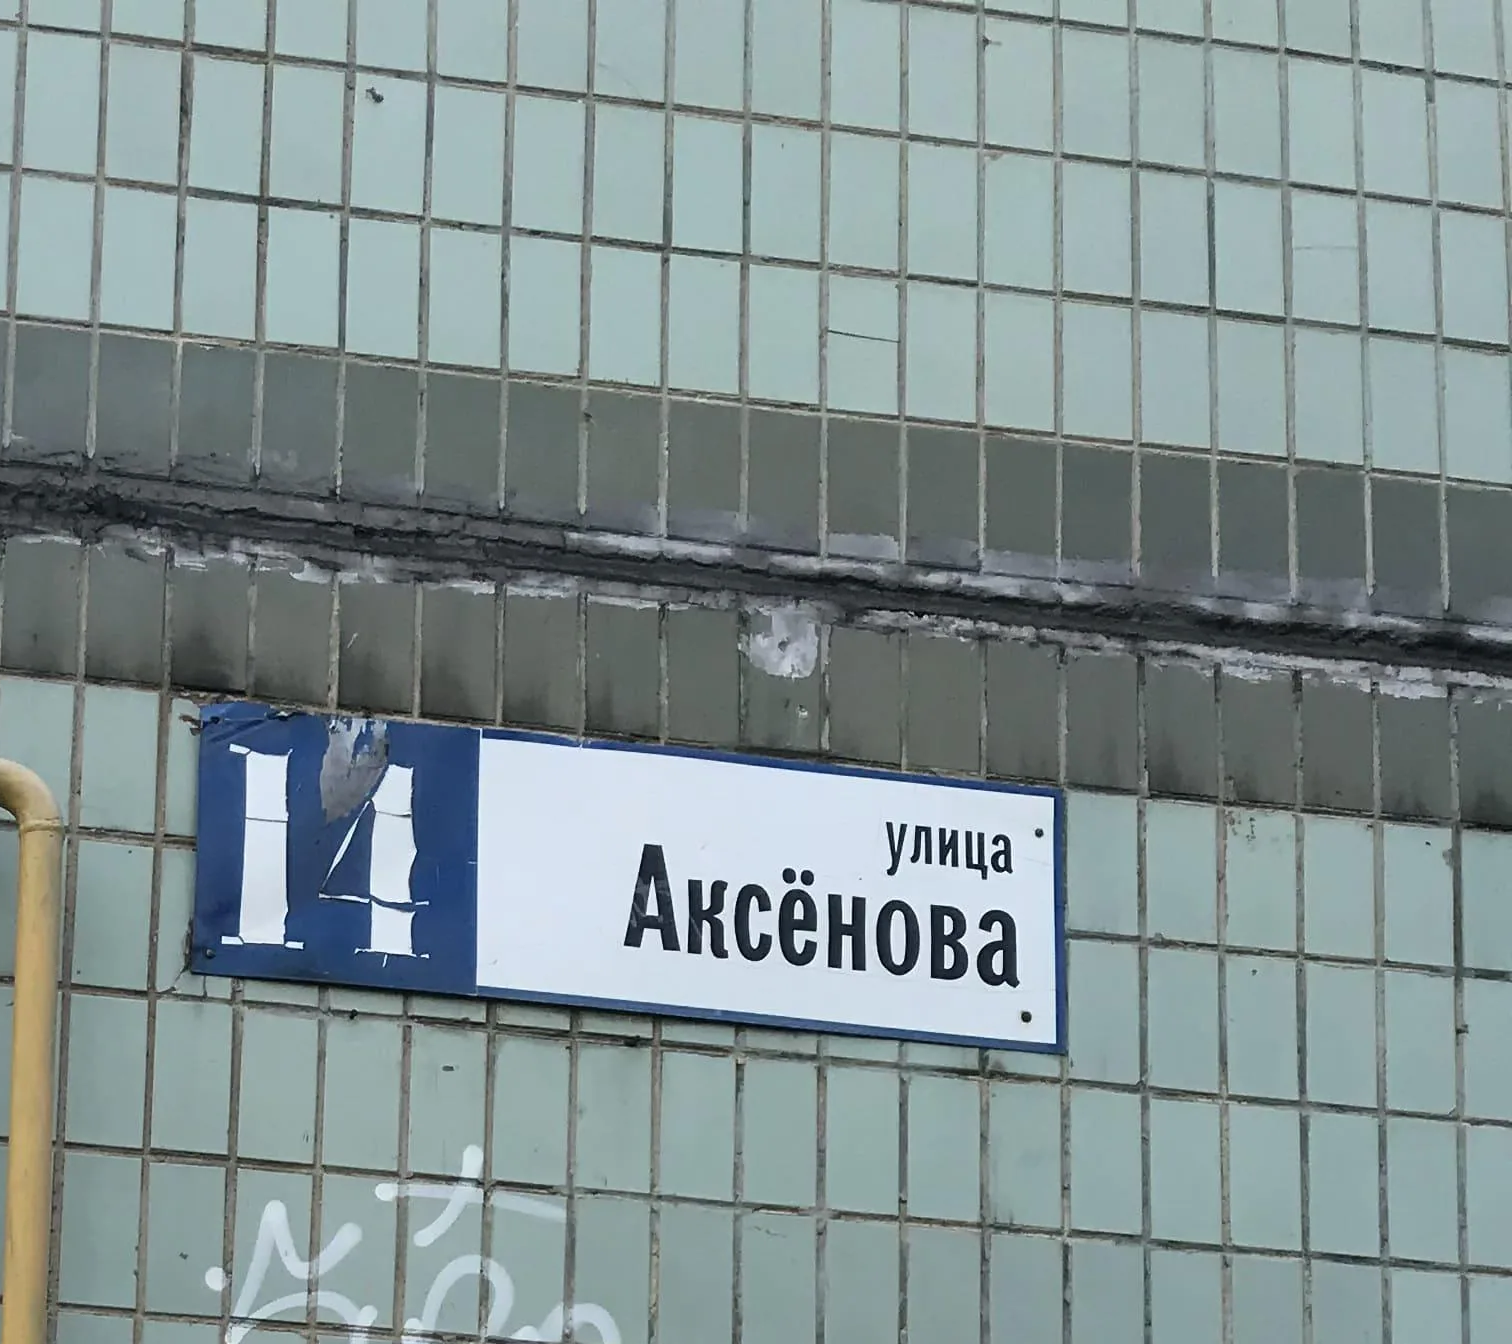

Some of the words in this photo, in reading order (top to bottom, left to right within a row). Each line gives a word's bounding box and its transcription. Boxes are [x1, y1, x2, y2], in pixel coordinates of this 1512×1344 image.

[221, 744, 429, 967] 14
[624, 842, 1021, 988] Аксёнова
[884, 819, 1014, 880] улица
